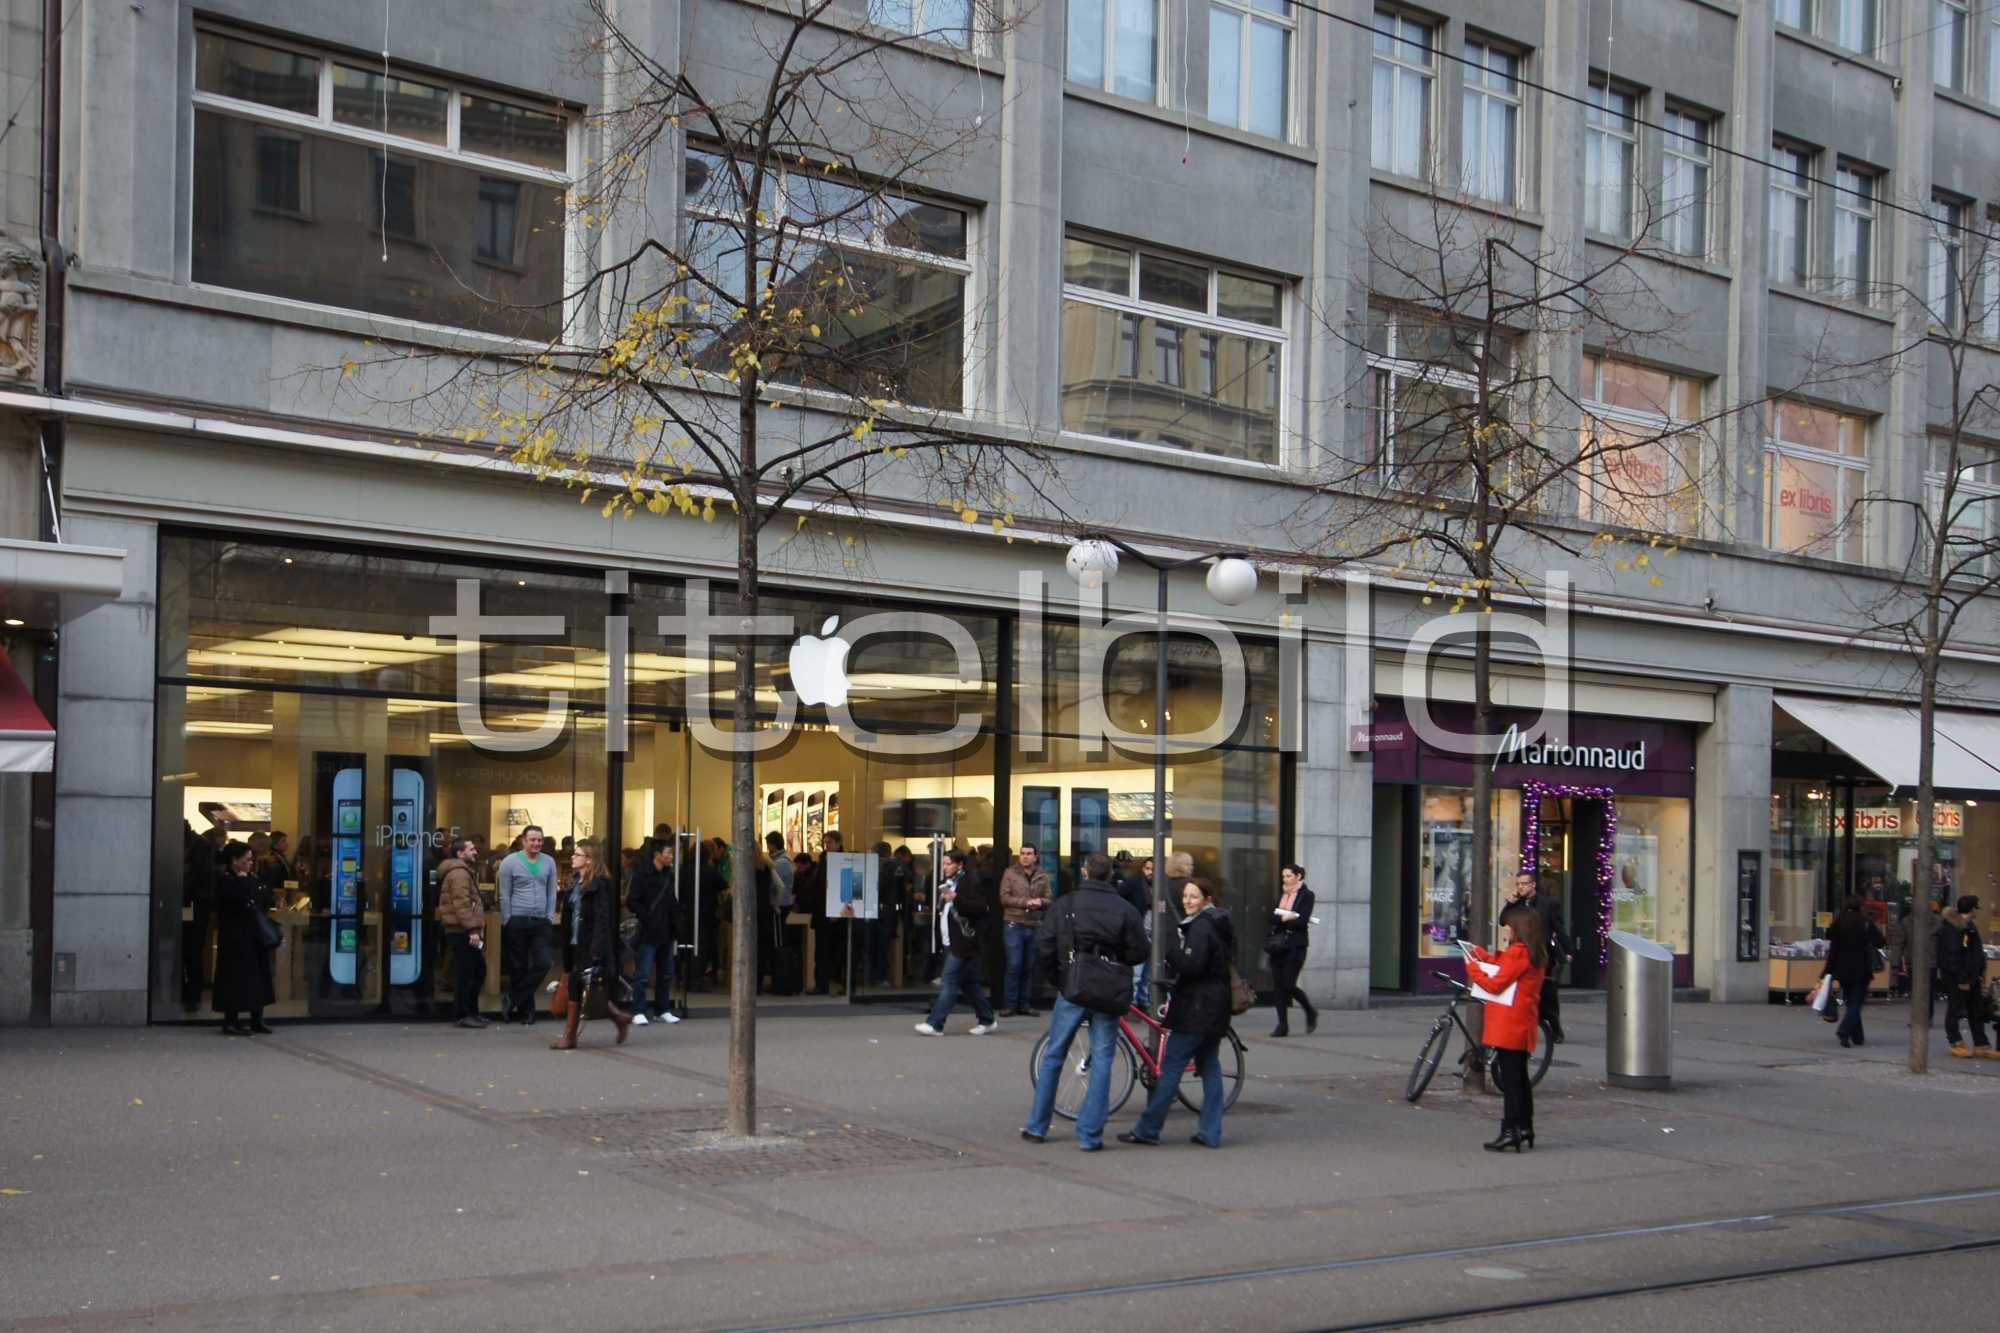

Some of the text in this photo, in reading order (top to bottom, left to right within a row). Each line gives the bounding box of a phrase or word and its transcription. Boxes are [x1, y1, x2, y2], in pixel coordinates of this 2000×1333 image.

[1780, 487, 1832, 513] ex libris
[1491, 722, 1646, 772] Marionnaud
[1854, 810, 1899, 829] ibris
[376, 824, 445, 849] iPhone
